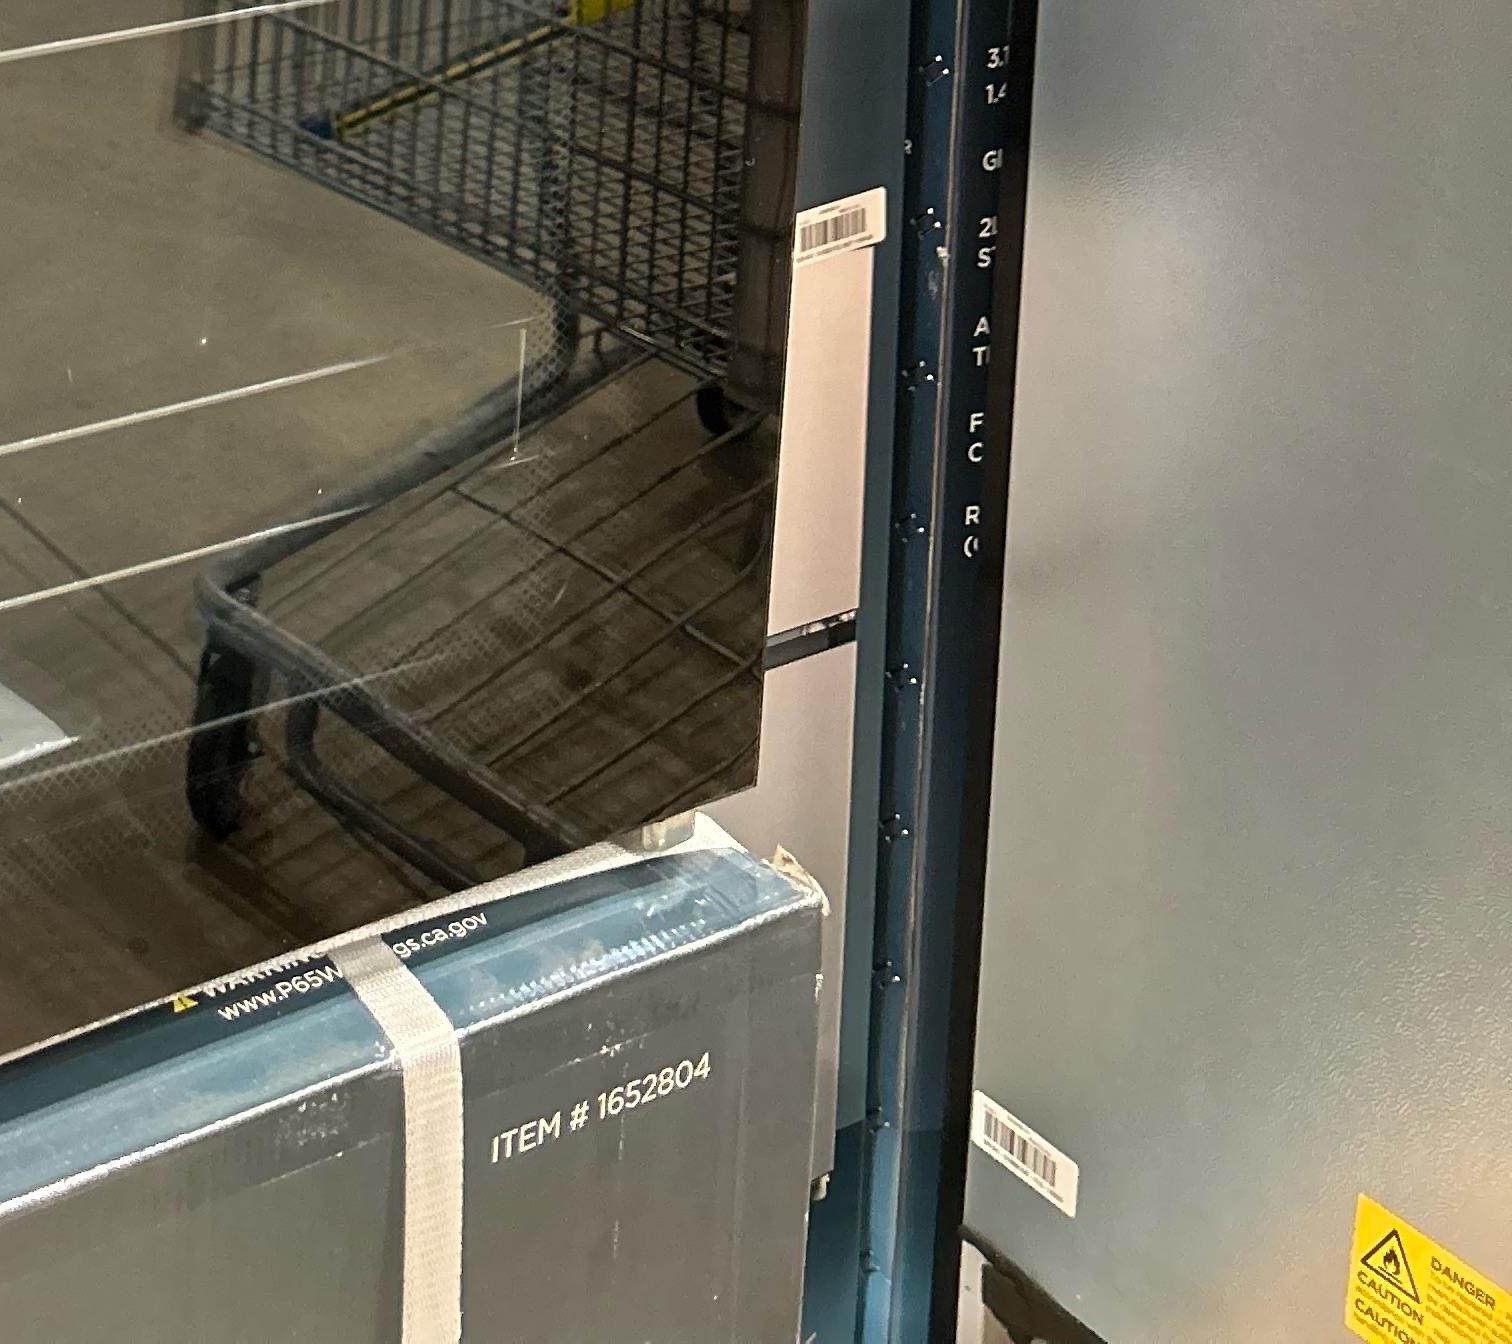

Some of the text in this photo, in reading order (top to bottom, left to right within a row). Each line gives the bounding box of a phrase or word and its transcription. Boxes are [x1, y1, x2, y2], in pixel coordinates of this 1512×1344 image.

[490, 1051, 712, 1164] ITEM # 1652804
[1356, 1269, 1425, 1326] CAUTION
[1431, 1255, 1497, 1312] DANGER
